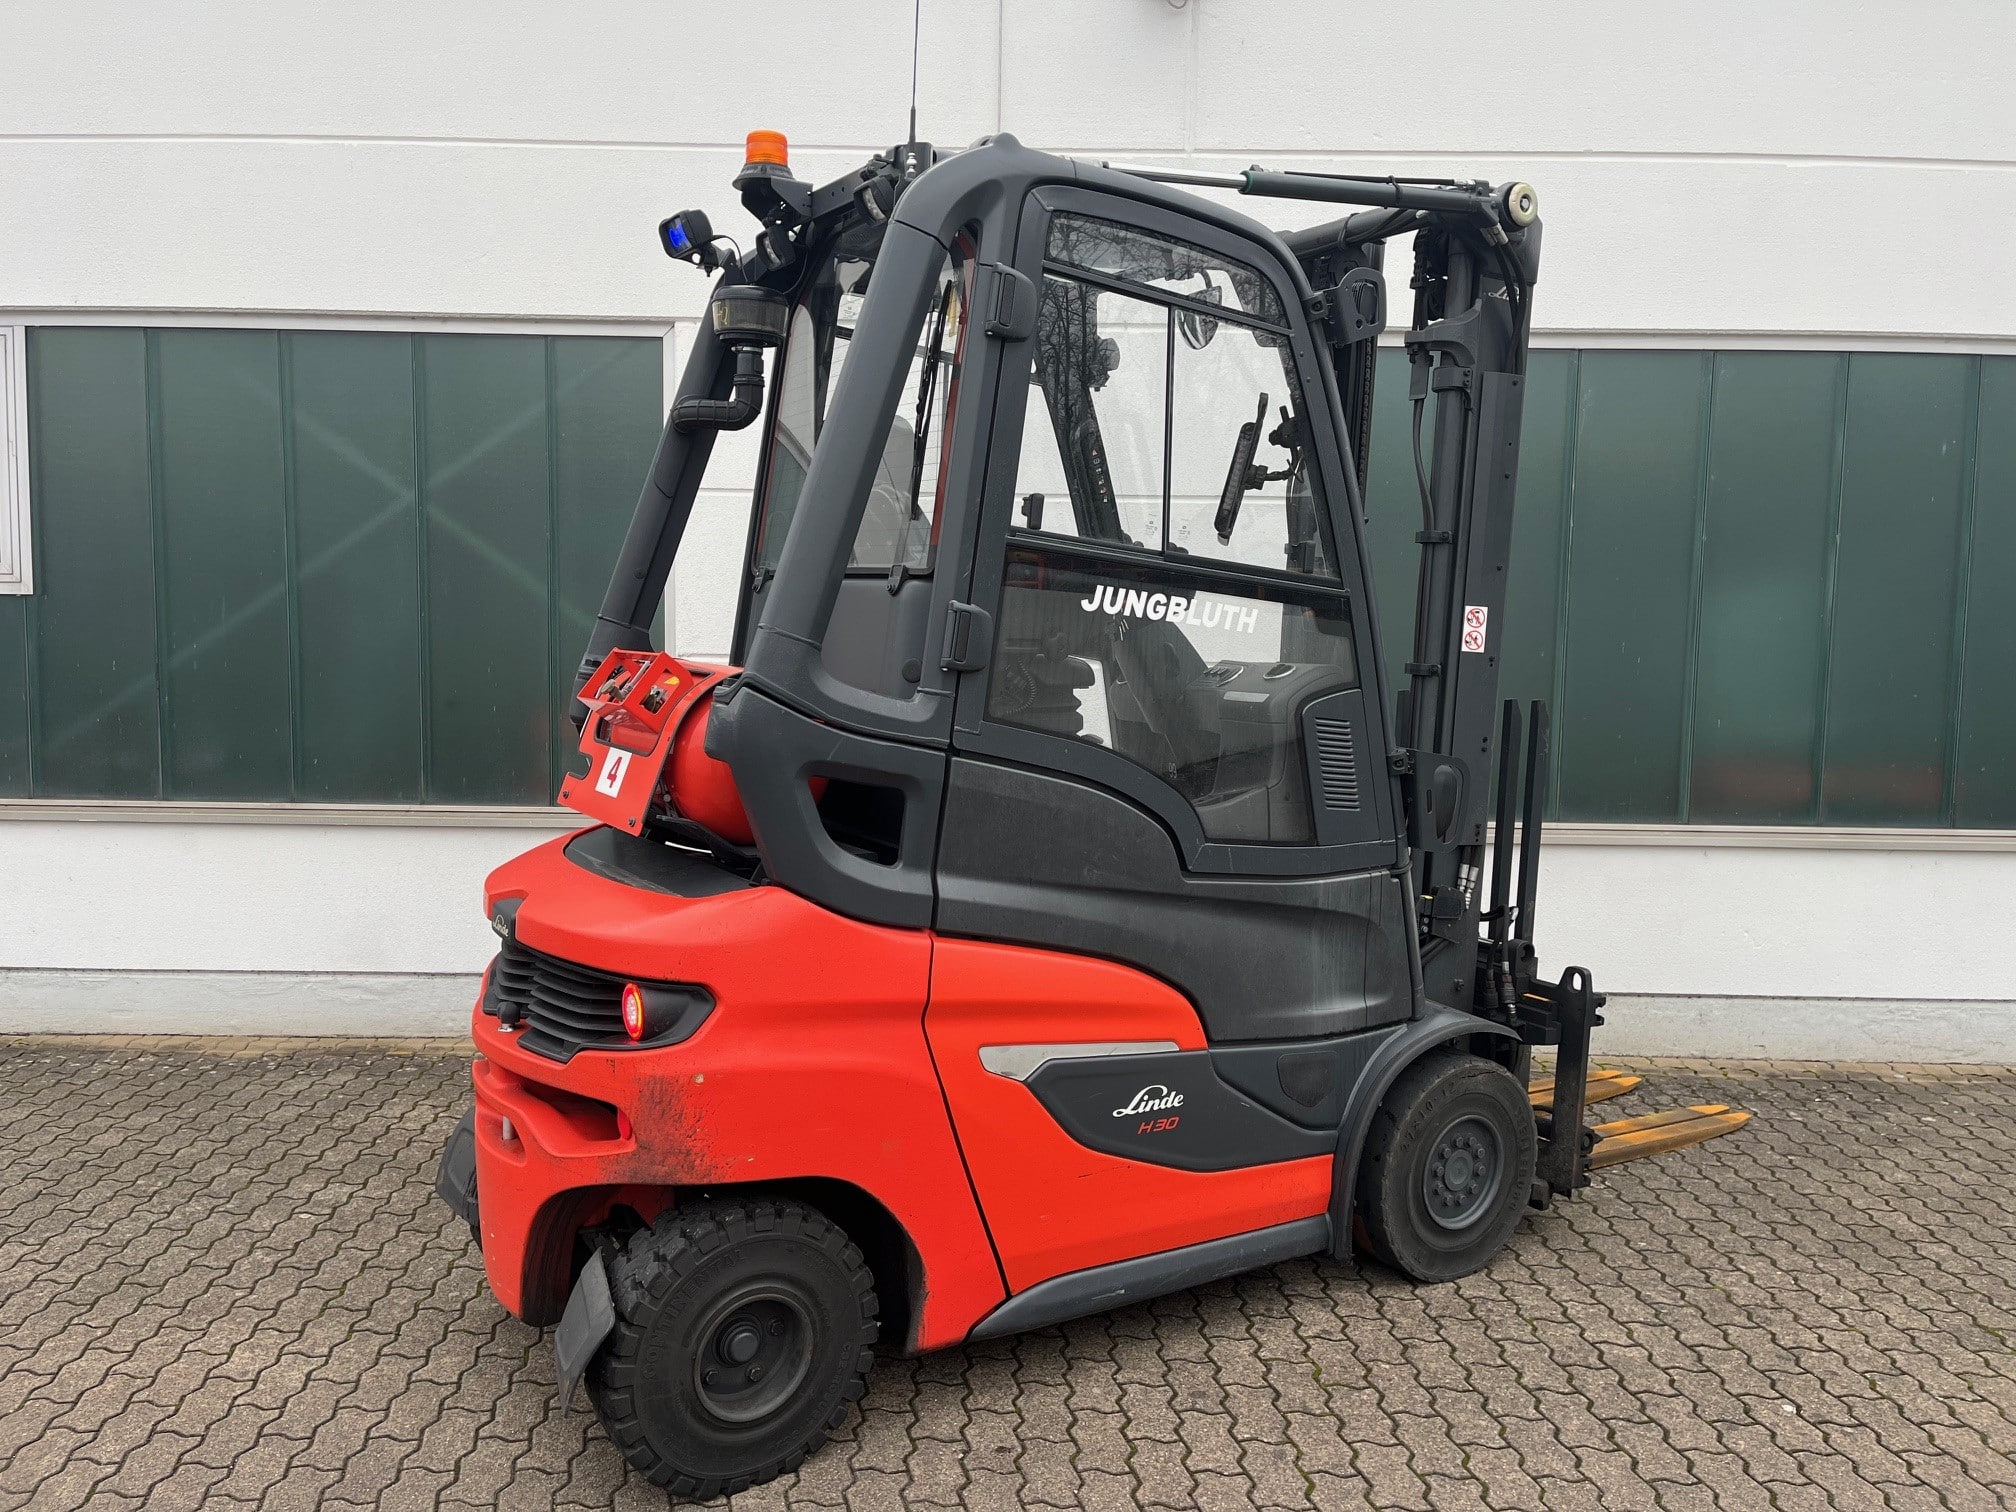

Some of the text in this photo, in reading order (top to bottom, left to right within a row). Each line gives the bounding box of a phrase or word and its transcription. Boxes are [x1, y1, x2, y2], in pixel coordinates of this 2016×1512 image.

[1080, 585, 1259, 634] JUNGBLUTH
[606, 756, 622, 788] 4
[1112, 1084, 1184, 1117] Linde
